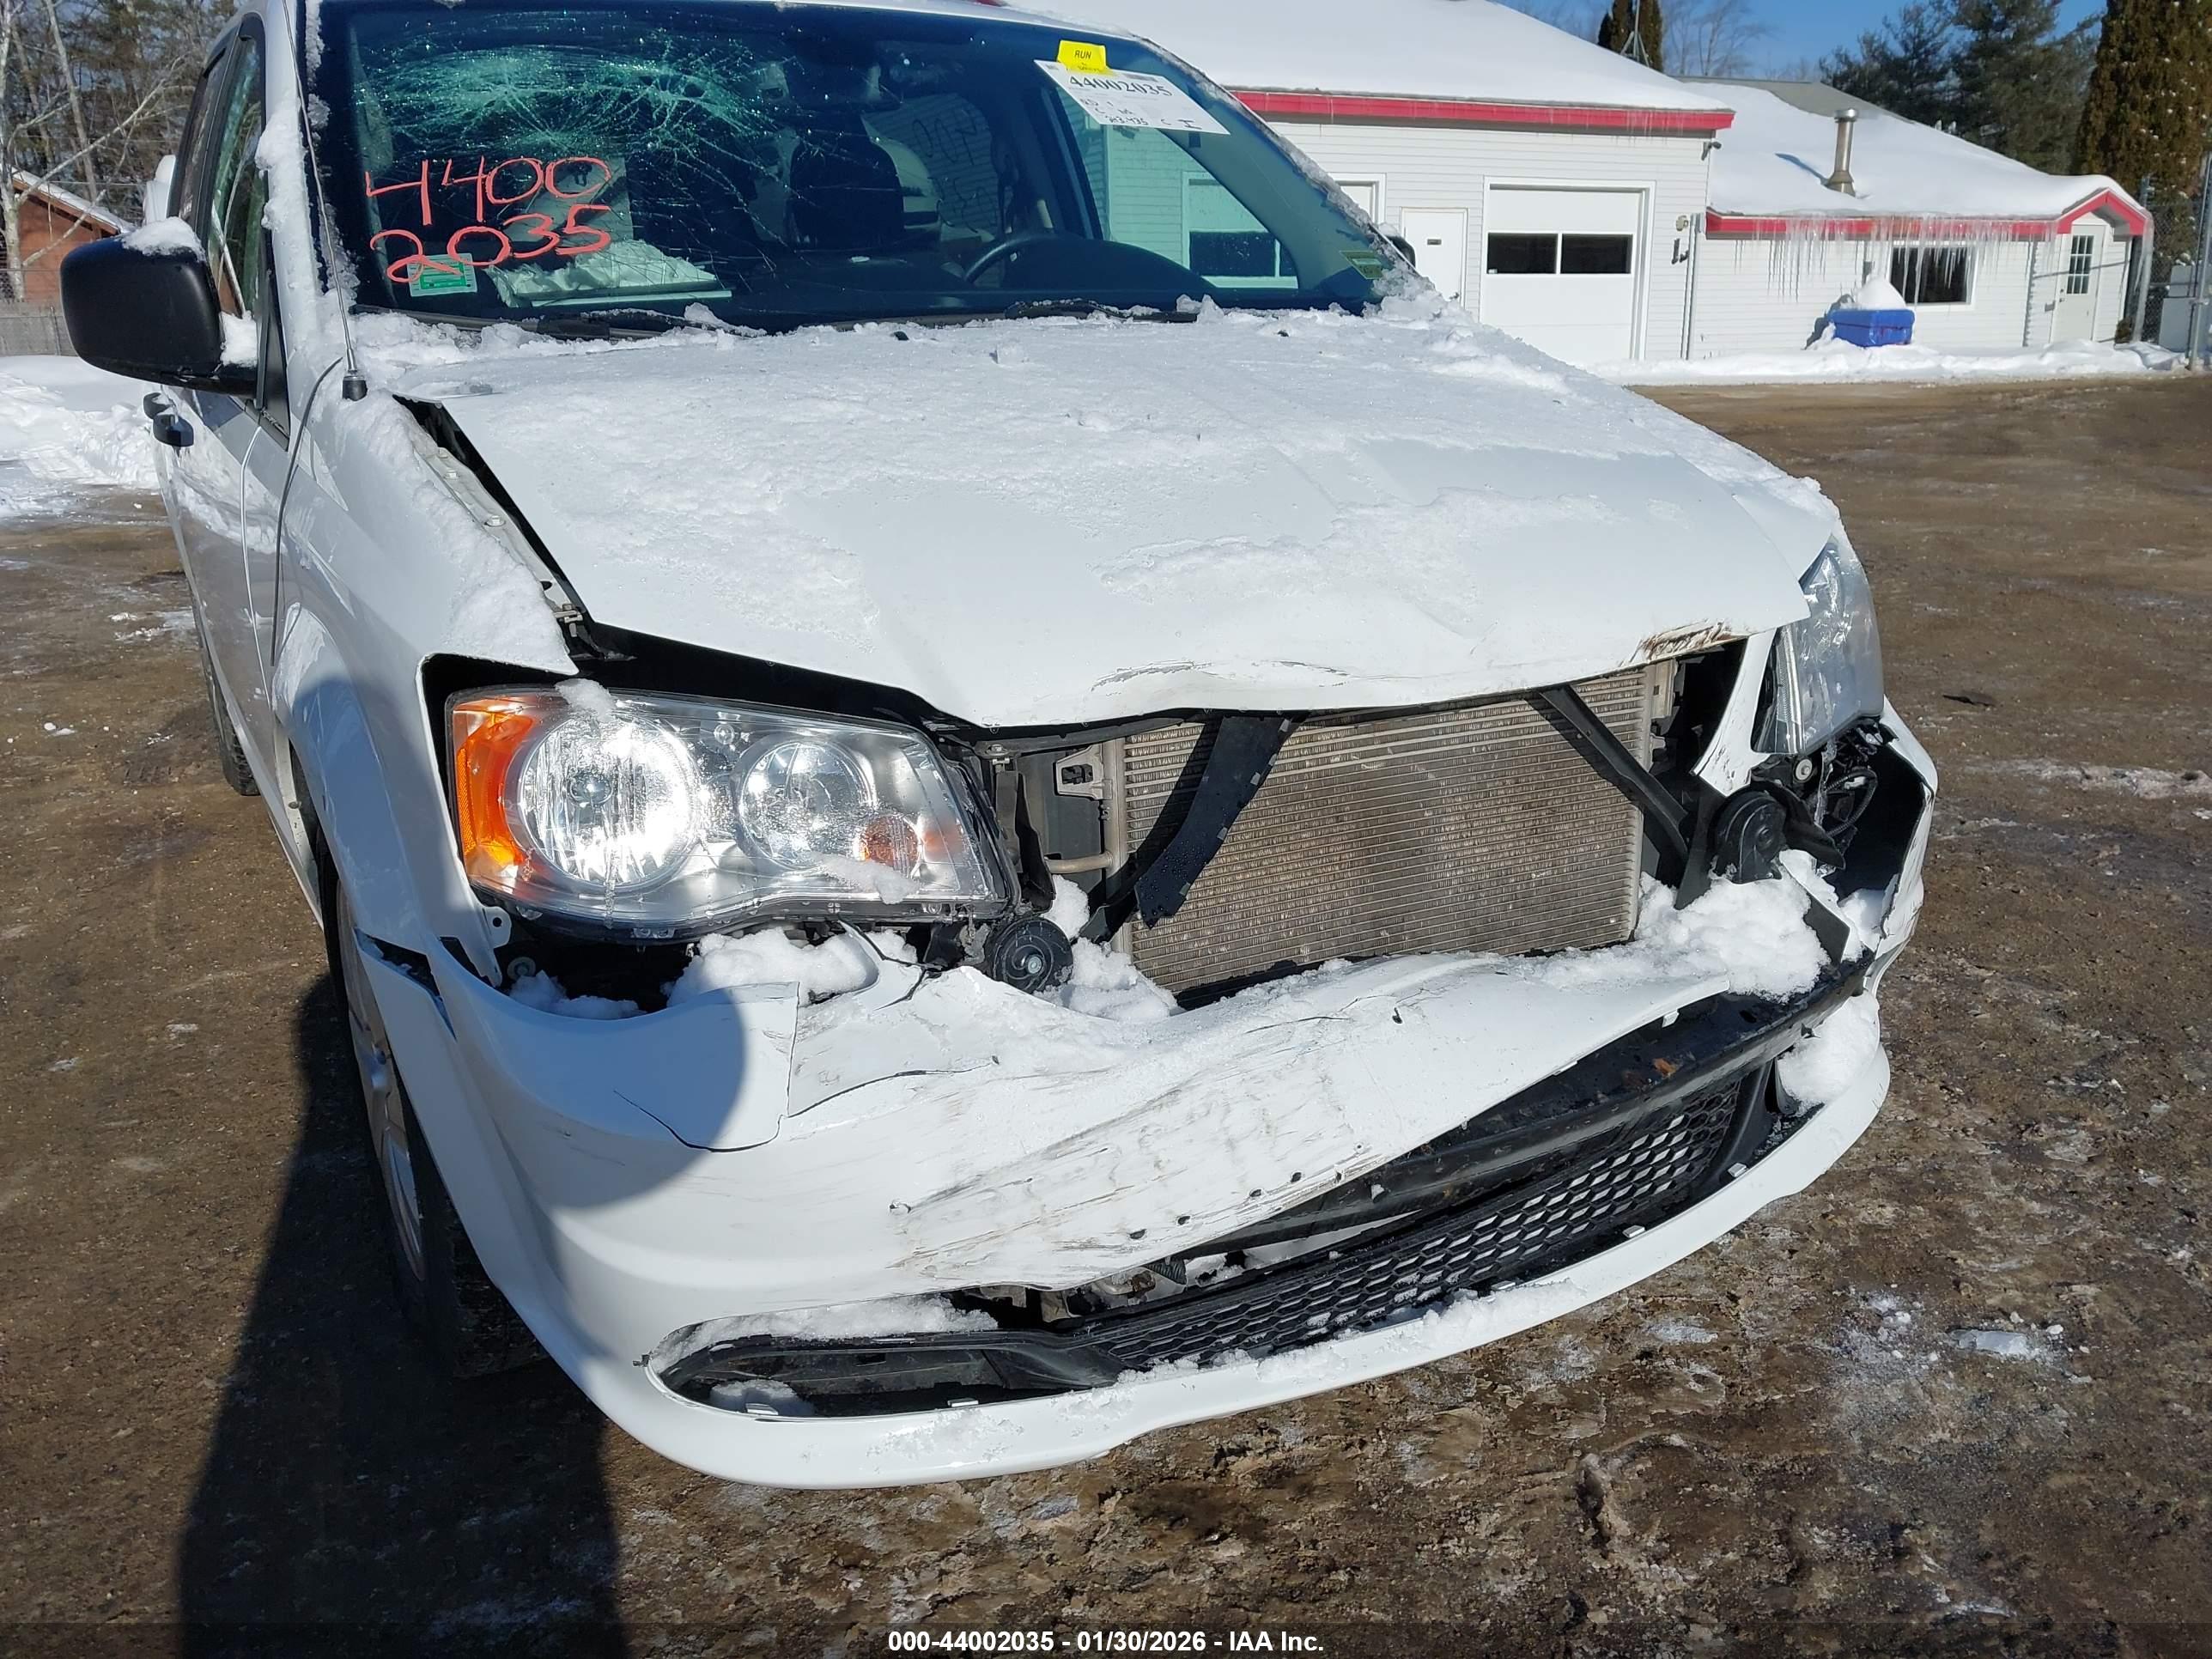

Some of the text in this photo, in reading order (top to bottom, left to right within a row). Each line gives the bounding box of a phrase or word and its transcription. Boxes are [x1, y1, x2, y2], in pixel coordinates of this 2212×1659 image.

[1073, 49, 1092, 60] RUN
[1069, 75, 1173, 97] 44002035
[366, 156, 612, 226] 4400
[370, 204, 611, 283] 2035
